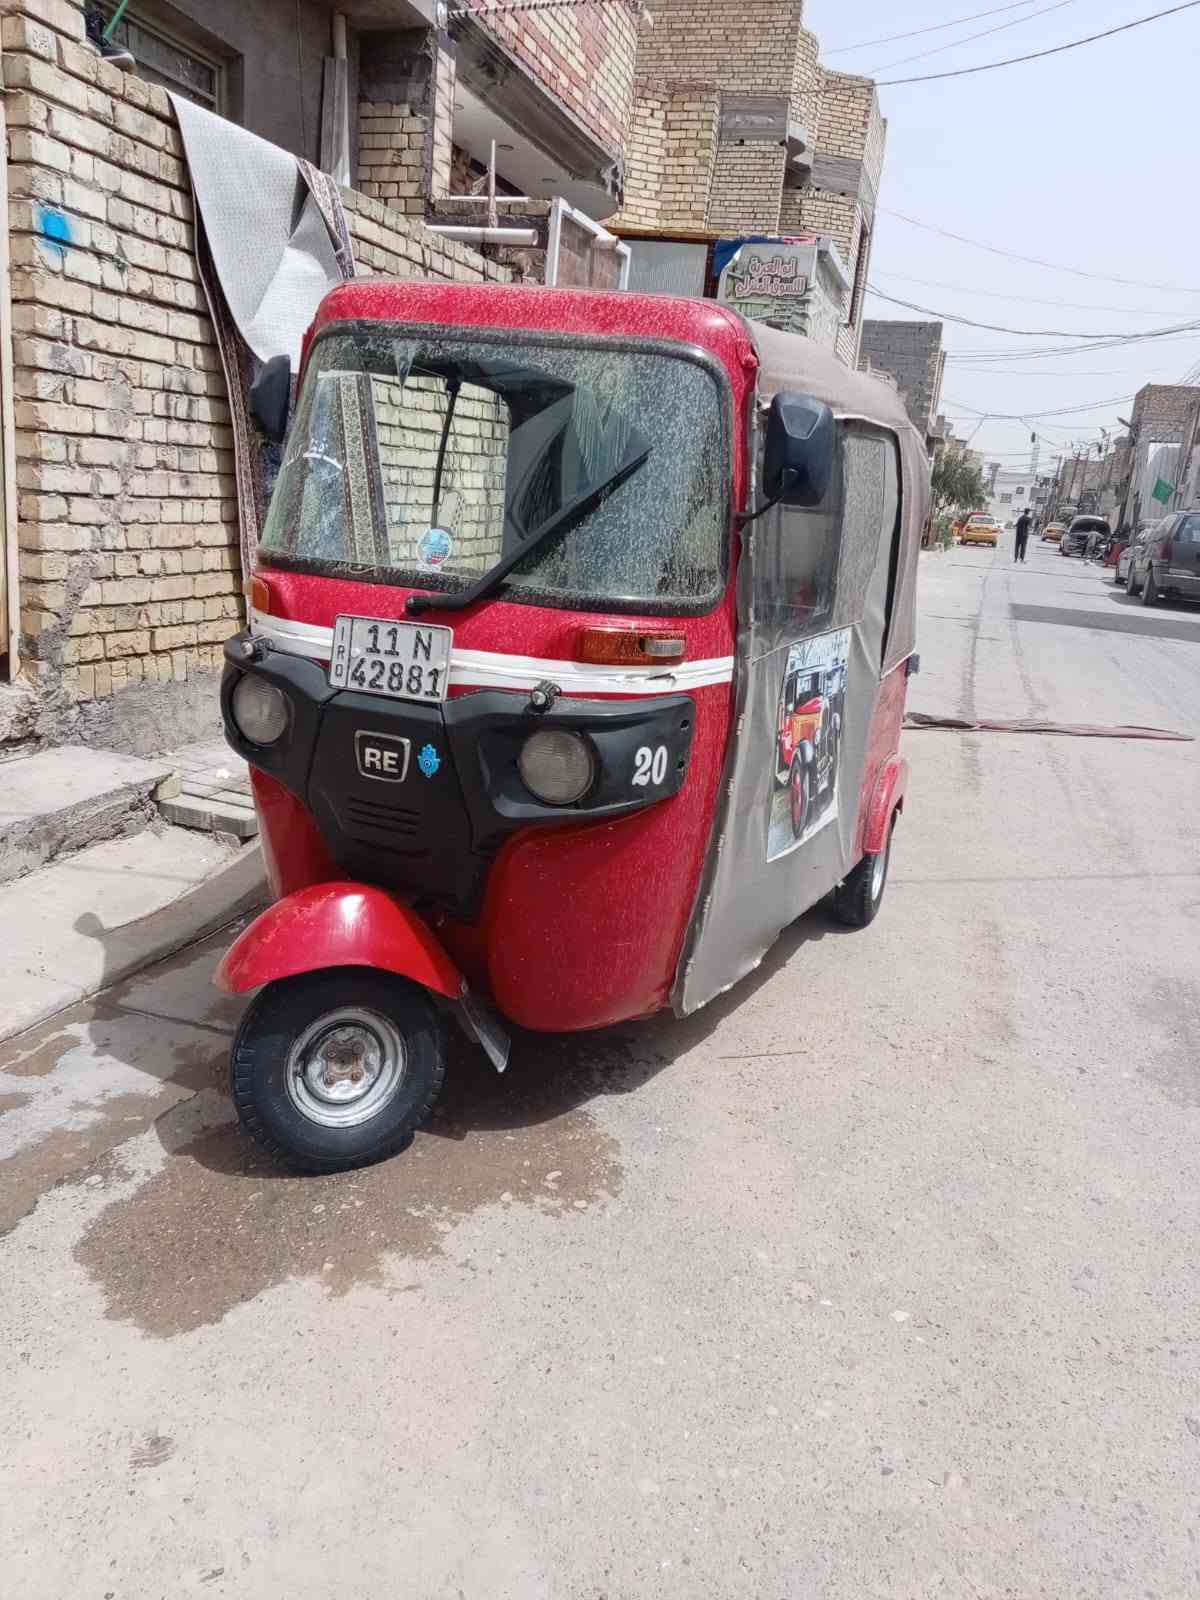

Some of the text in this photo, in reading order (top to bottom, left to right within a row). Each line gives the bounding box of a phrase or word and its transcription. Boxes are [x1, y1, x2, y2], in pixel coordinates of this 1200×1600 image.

[365, 624, 433, 661] 11 N
[350, 657, 440, 698] 42881
[365, 747, 399, 774] RE
[631, 745, 668, 786] 20
